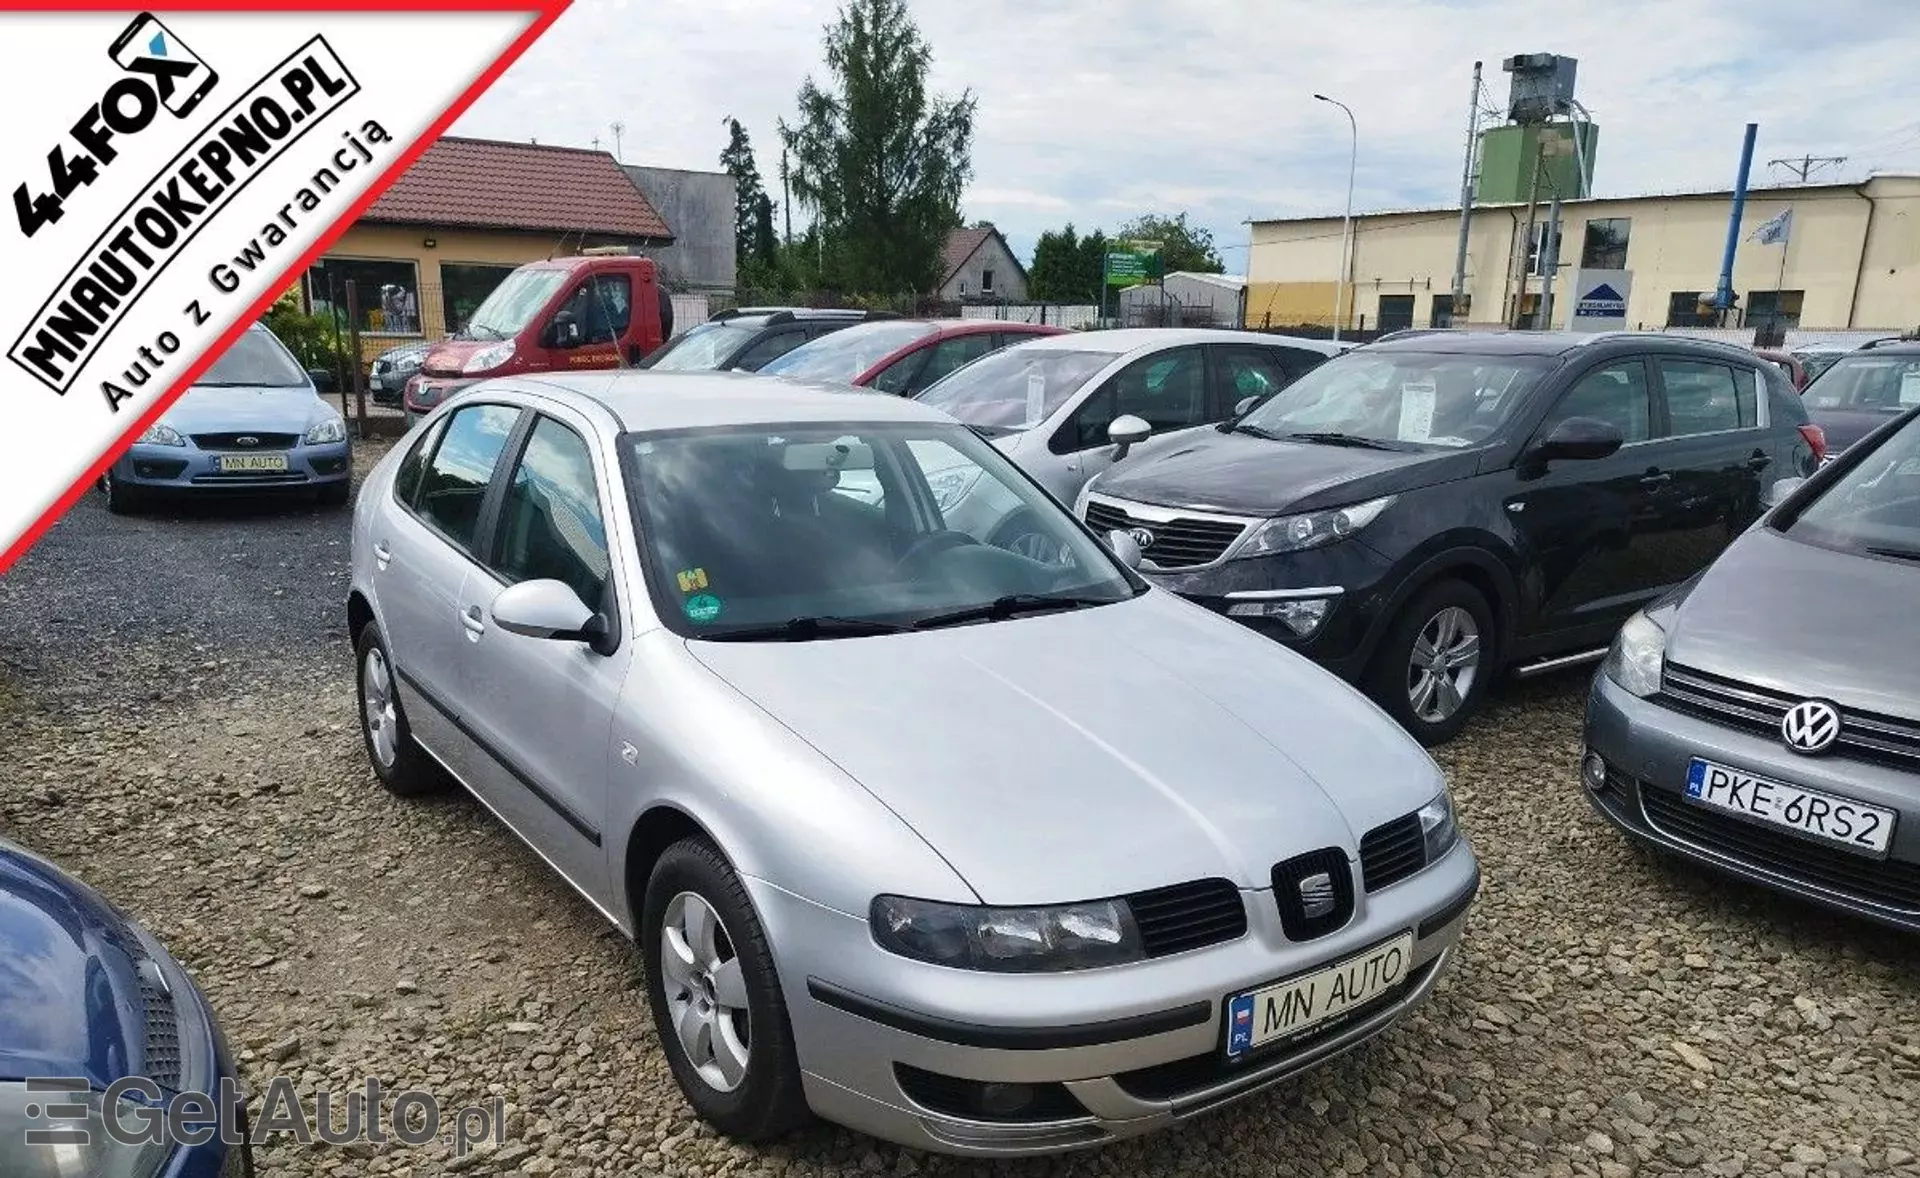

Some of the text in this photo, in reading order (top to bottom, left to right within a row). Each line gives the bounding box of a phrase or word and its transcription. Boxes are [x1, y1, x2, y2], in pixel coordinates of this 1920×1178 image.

[225, 457, 283, 468] MN AUTO
[1689, 782, 1700, 793] PL
[1707, 769, 1880, 846] PKE 6RS2
[1264, 983, 1315, 1035] MN
[1325, 947, 1402, 1011] AUTO
[1234, 1031, 1248, 1044] PL
